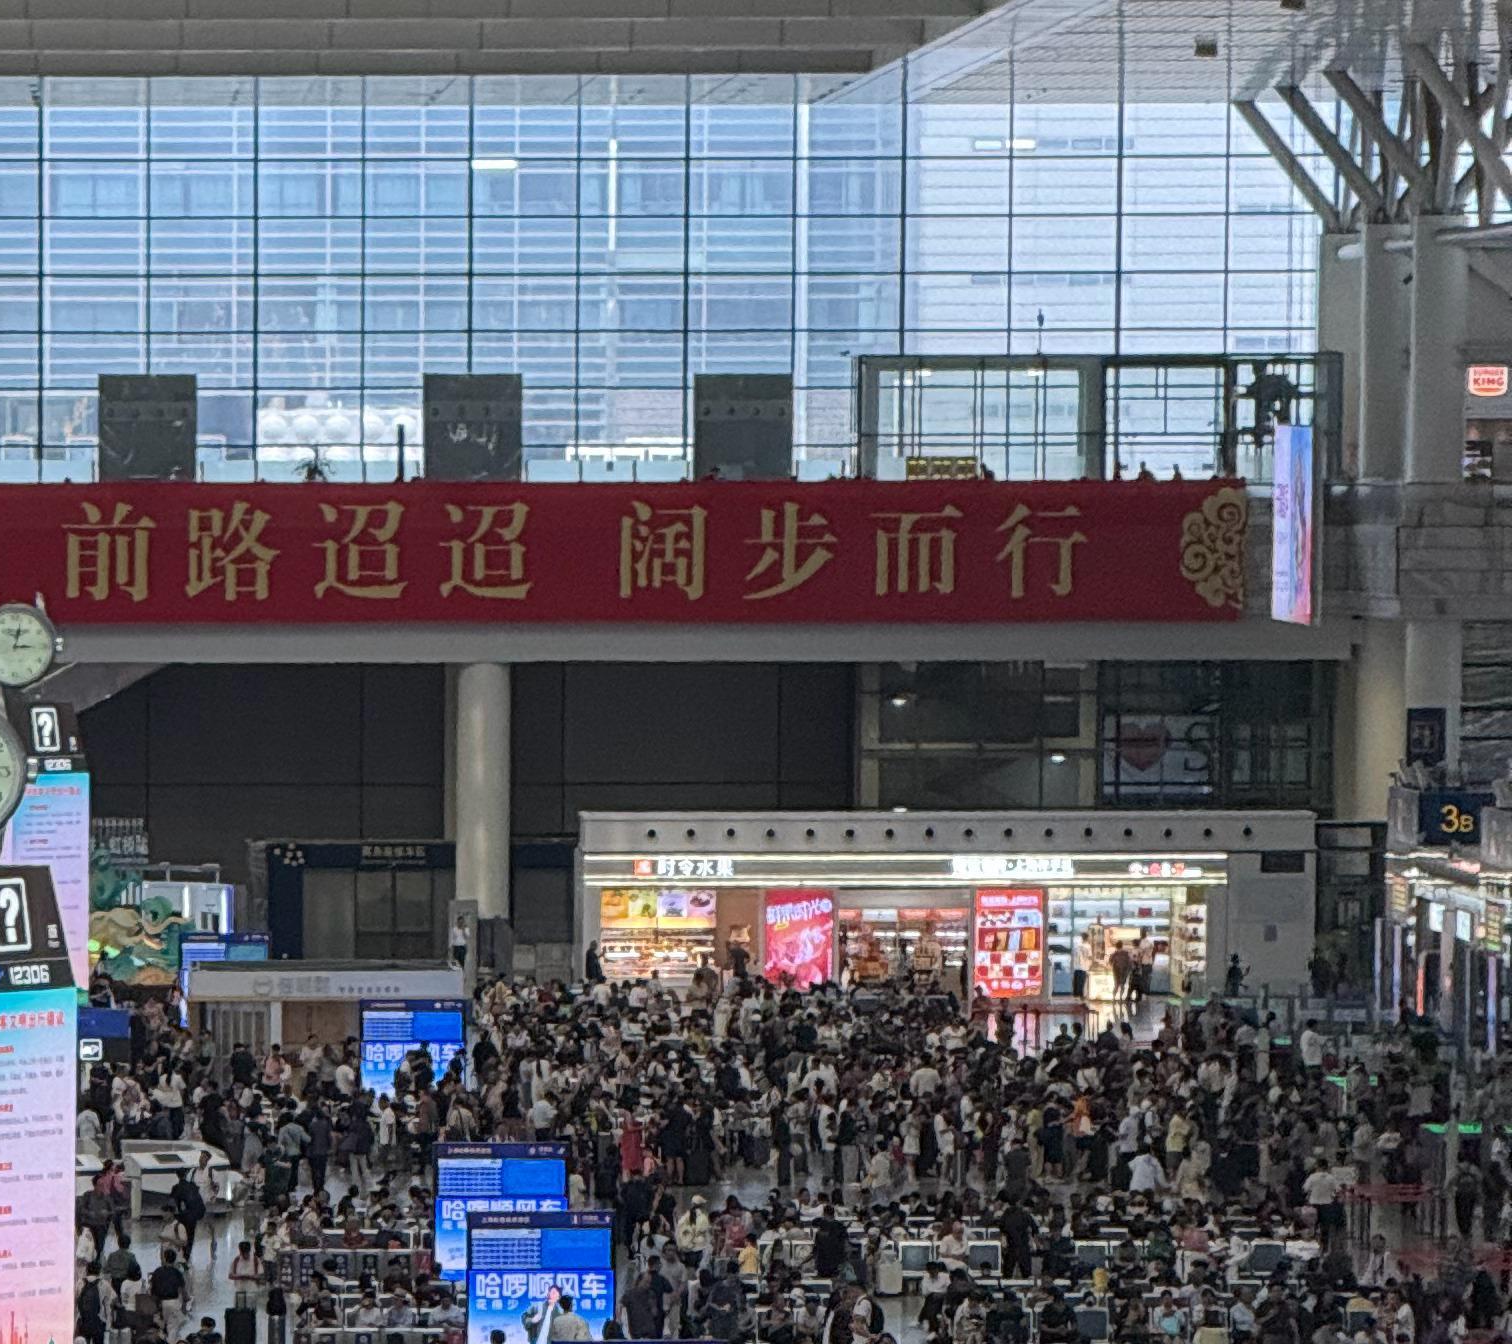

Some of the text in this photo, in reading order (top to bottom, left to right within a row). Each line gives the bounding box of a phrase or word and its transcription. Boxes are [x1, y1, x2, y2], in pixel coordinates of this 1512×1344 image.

[1473, 377, 1505, 387] KING
[62, 502, 531, 600] 前路迢迢
[618, 501, 1088, 600] 阔步而行
[1440, 804, 1474, 833] 3B
[657, 856, 736, 877] 时令水果
[8, 964, 50, 986] 12306
